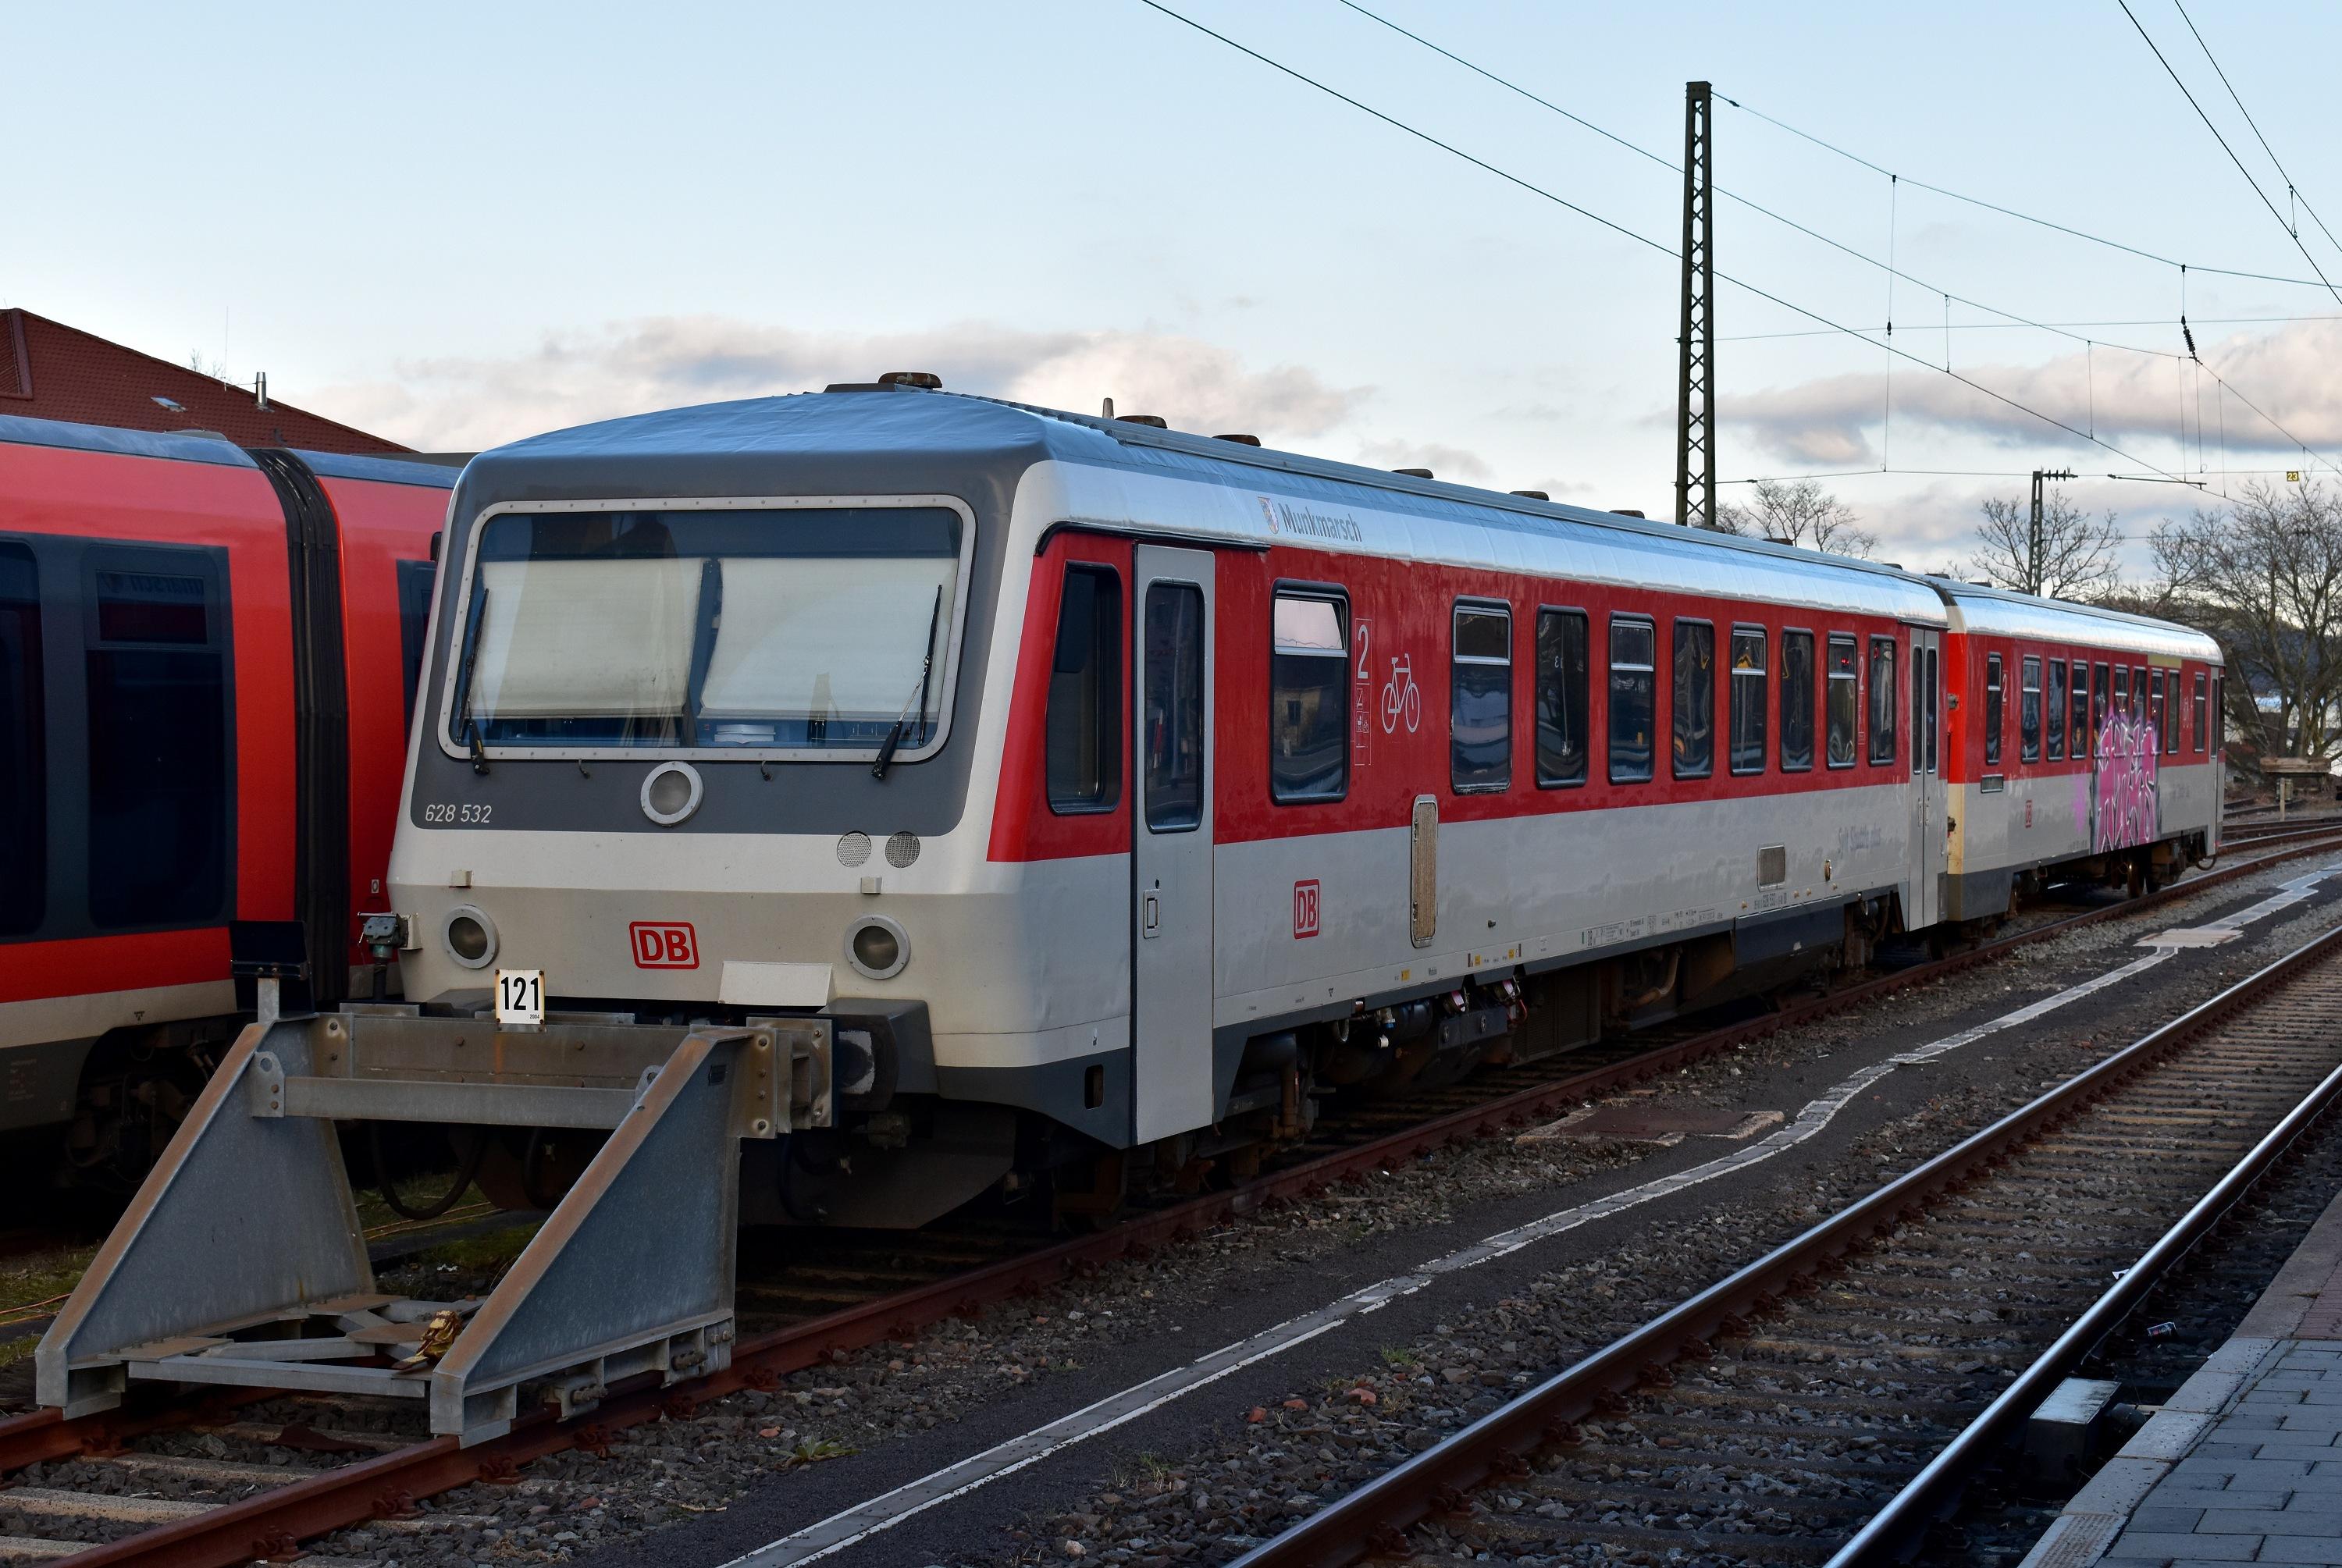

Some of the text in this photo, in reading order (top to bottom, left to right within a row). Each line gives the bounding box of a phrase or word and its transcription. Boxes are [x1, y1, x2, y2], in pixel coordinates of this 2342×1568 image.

[2287, 472, 2298, 481] 23
[1278, 503, 1362, 542] Munkmarsch
[1358, 624, 1369, 679] 2
[1859, 656, 1864, 690] 2
[2002, 674, 2007, 702] 2
[425, 804, 492, 823] 628 532
[1297, 889, 1317, 930] DB
[639, 929, 690, 962] DB
[500, 976, 539, 1011] 121
